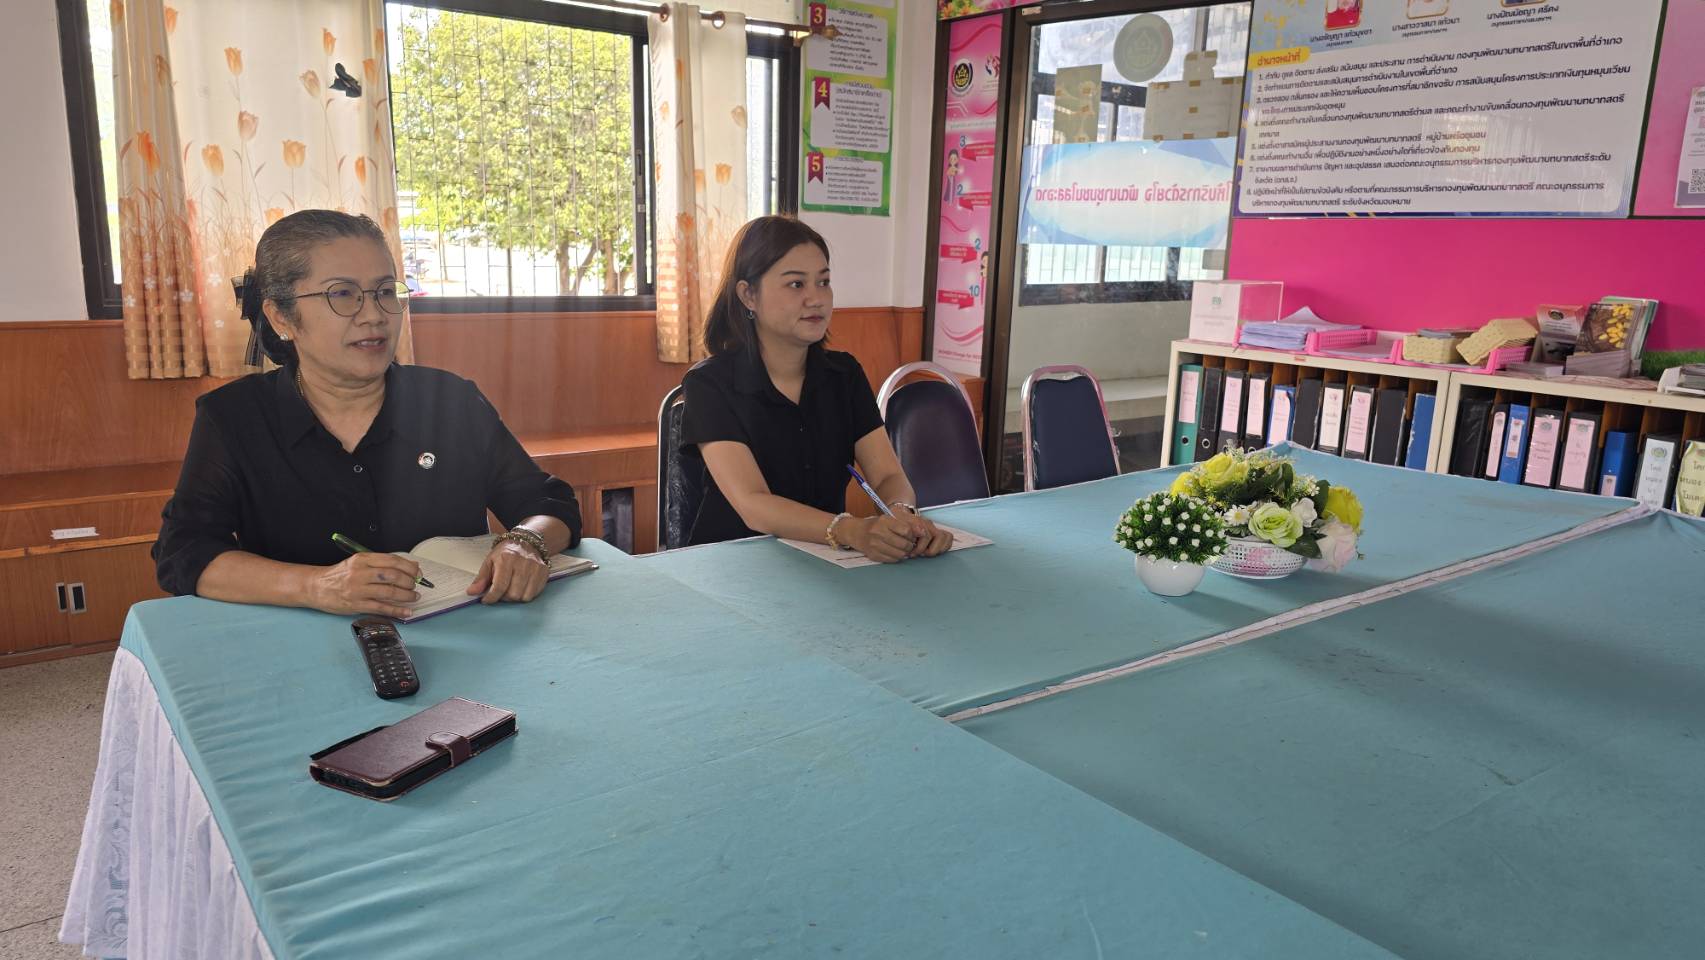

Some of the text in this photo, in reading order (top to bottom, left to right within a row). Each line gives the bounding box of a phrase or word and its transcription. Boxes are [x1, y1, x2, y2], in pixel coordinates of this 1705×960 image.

[814, 8, 823, 24] 3
[818, 81, 828, 97] 4
[960, 136, 966, 147] 3
[811, 156, 821, 172] 5
[956, 184, 963, 195] 2
[974, 238, 981, 250] 2
[969, 285, 980, 297] 10
